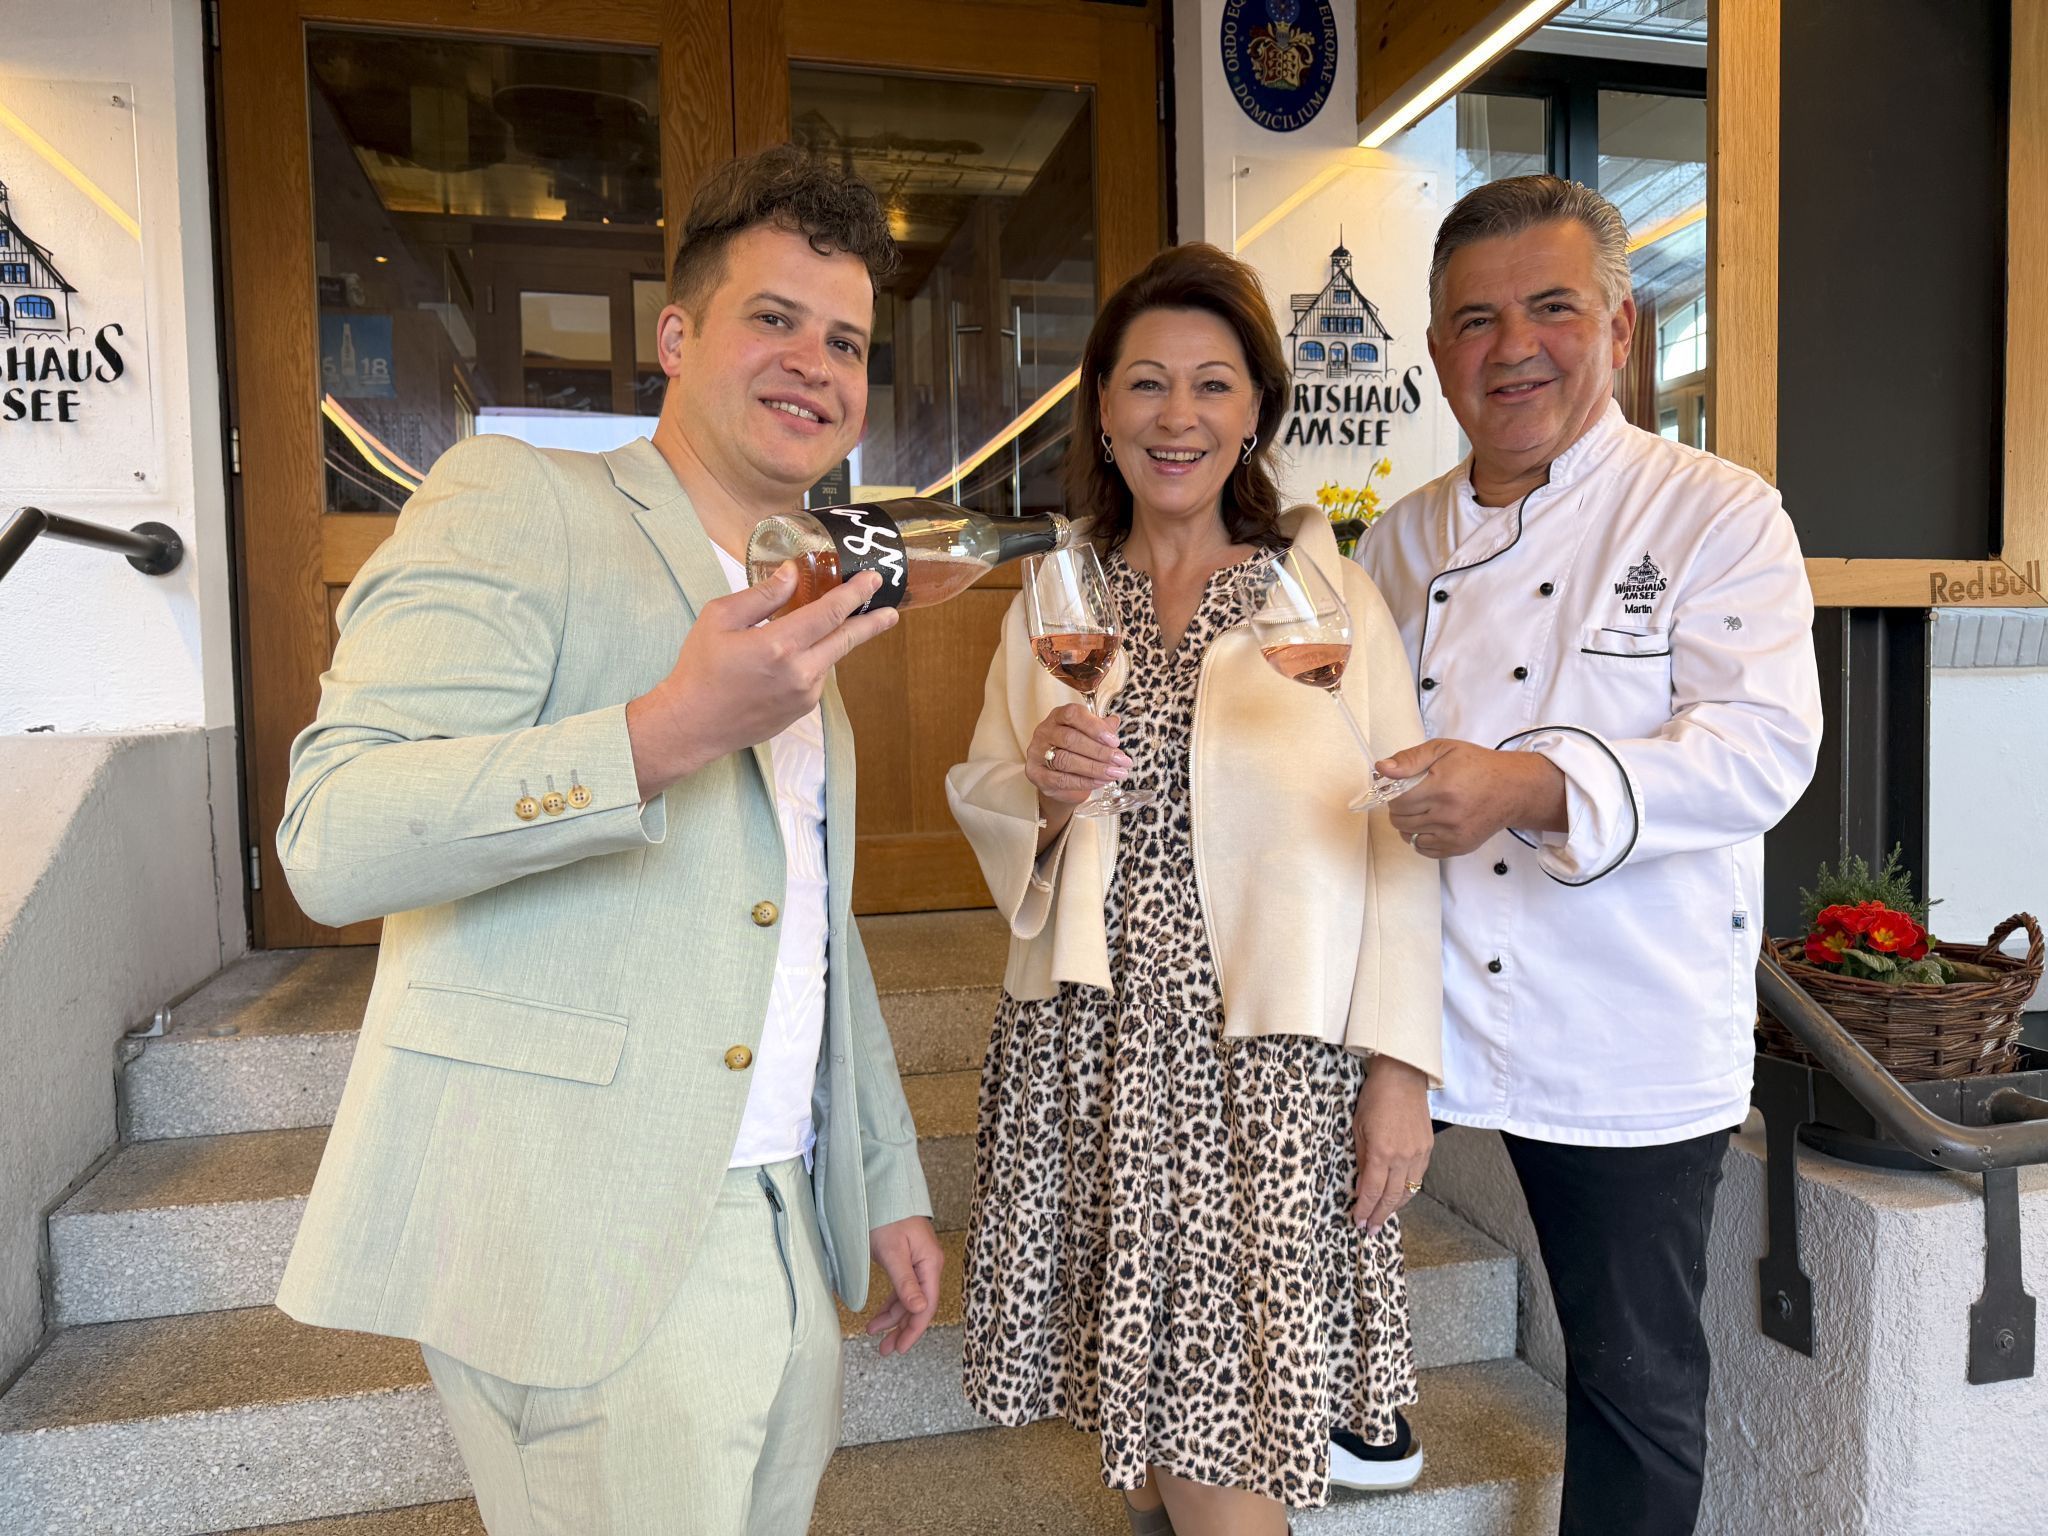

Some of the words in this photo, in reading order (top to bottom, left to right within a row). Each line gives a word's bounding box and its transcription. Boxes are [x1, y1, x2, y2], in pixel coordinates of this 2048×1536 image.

[1224, 22, 1240, 72] ORDO
[1318, 5, 1336, 84] EUROPAE
[1234, 83, 1324, 129] DOMICILIUM
[0, 323, 124, 384] HAUS
[3, 387, 80, 422] SEE
[1294, 365, 1423, 414] RTSHAUS
[1284, 416, 1333, 446] AM
[1339, 418, 1391, 446] SEE
[1622, 592, 1639, 601] AM
[1638, 591, 1657, 600] SEE
[1930, 566, 1984, 605] Red
[1989, 560, 2041, 598] Bull
[1624, 603, 1653, 614] Martin
